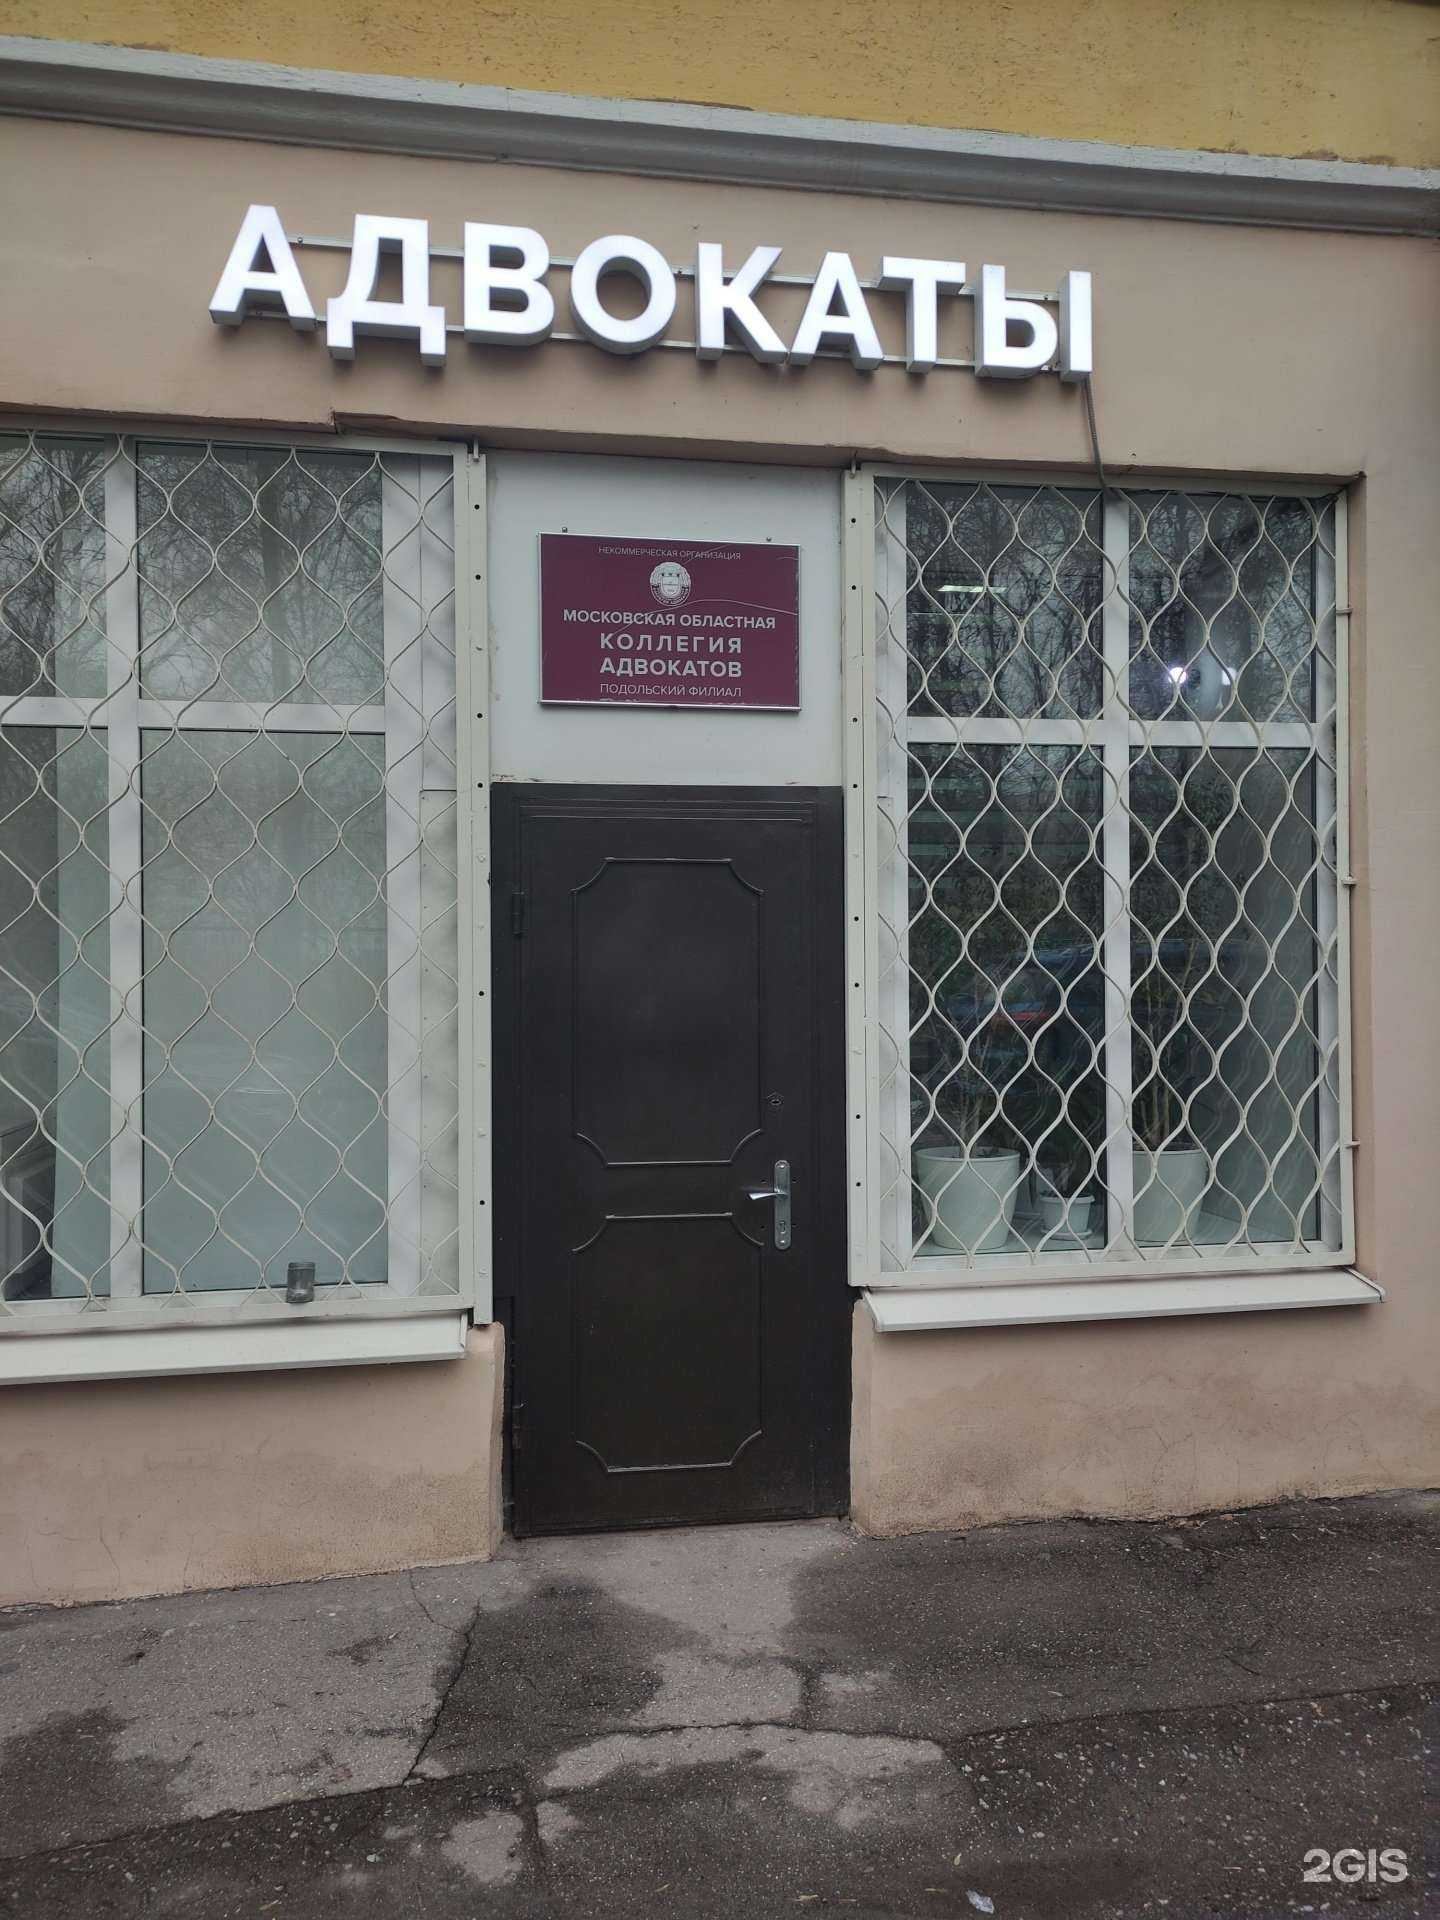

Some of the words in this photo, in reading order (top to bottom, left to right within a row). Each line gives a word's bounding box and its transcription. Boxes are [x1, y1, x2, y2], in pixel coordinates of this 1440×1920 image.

[209, 204, 1092, 379] АДВОКАТЫ
[598, 546, 678, 558] НЕКОММЕРЧЕСКАЯ
[679, 550, 742, 561] ОРГАНИЗАЦИЯ
[563, 608, 676, 626] МОСКОВСКАЯ
[679, 614, 776, 629] ОБЛАСТНАЯ
[600, 633, 742, 654] КОЛЛЕГИЯ
[600, 657, 742, 678] АДВОКАТОВ
[600, 683, 686, 697] ПОДОЛЬСКИЙ
[688, 685, 742, 697] ФИЛИАЛ
